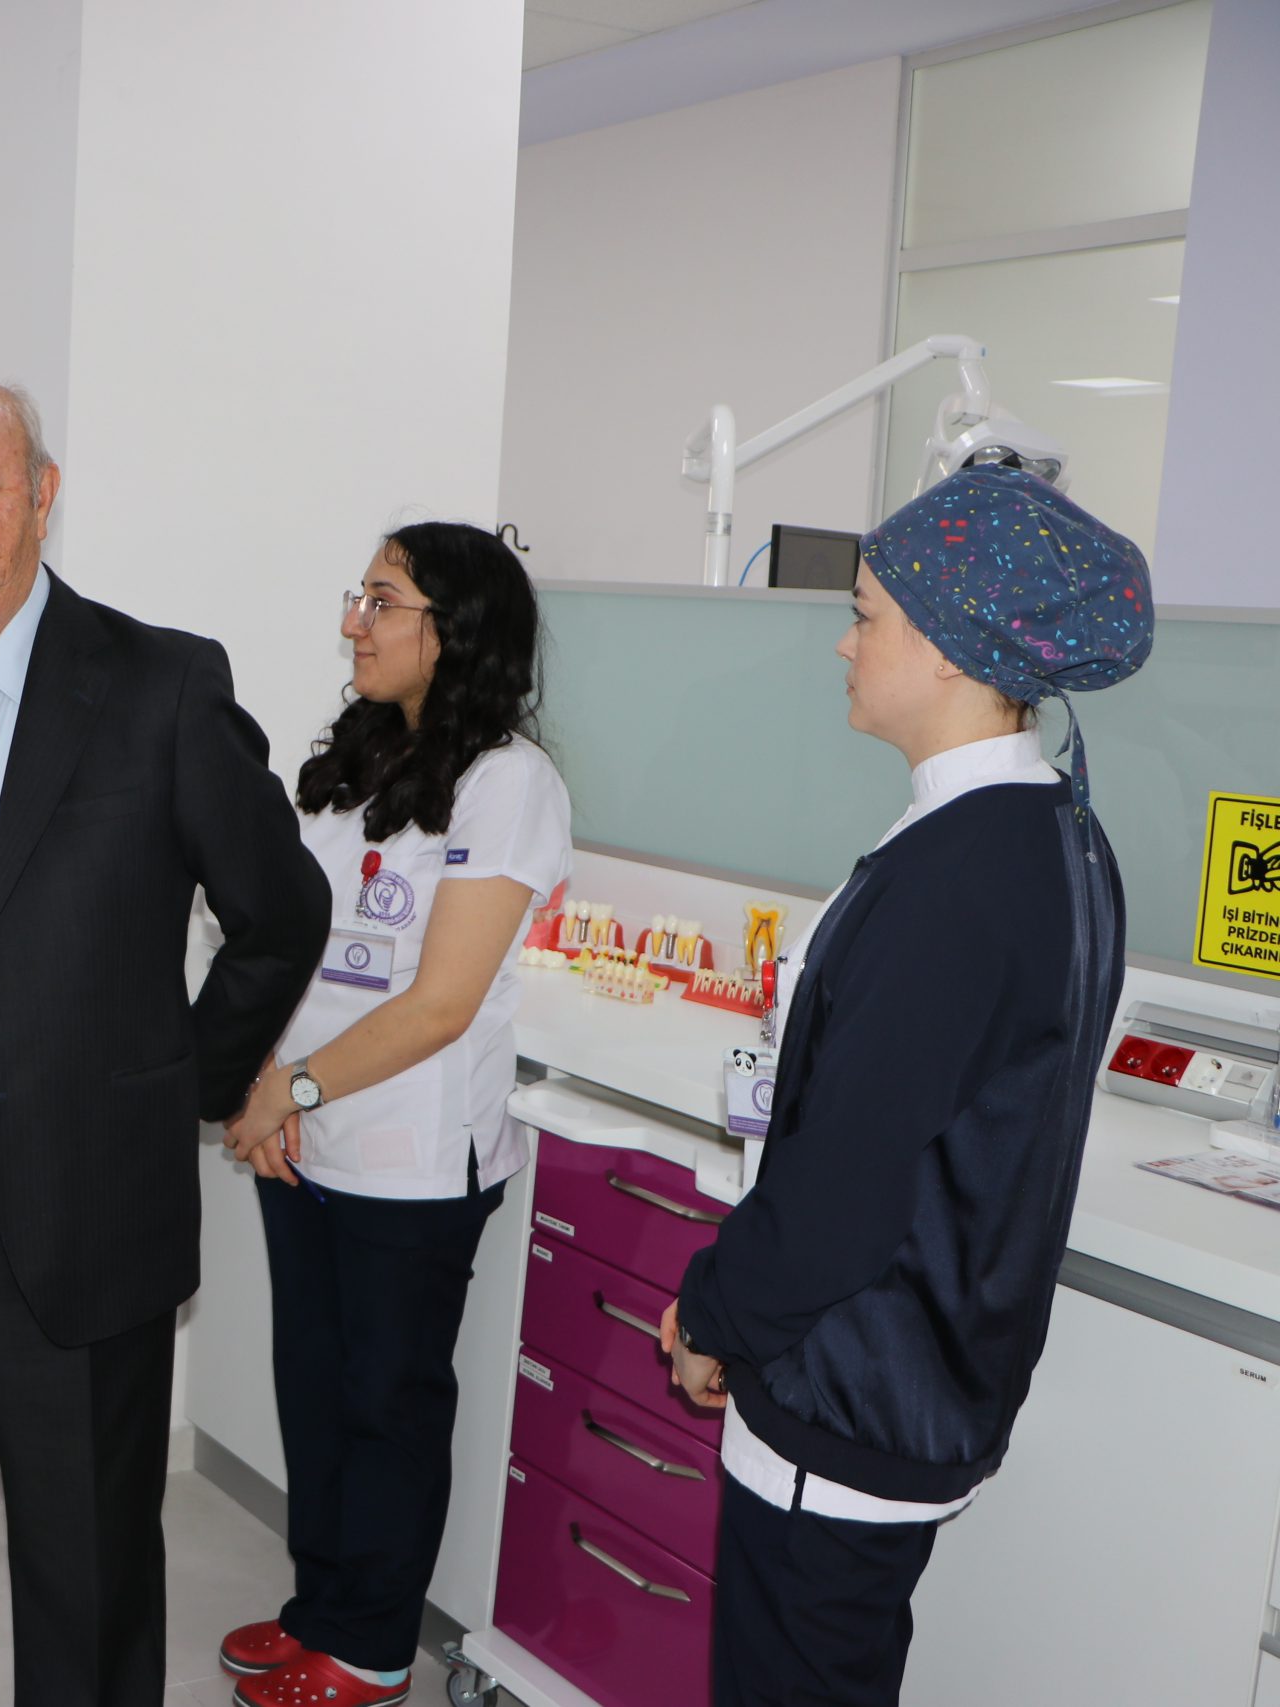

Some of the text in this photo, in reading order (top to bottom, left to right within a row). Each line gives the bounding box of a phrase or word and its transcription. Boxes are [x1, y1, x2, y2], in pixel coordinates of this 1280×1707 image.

[1223, 905, 1239, 922] İŞİ
[1228, 926, 1280, 946] PRİZDE
[1239, 1368, 1267, 1383] SERUM
